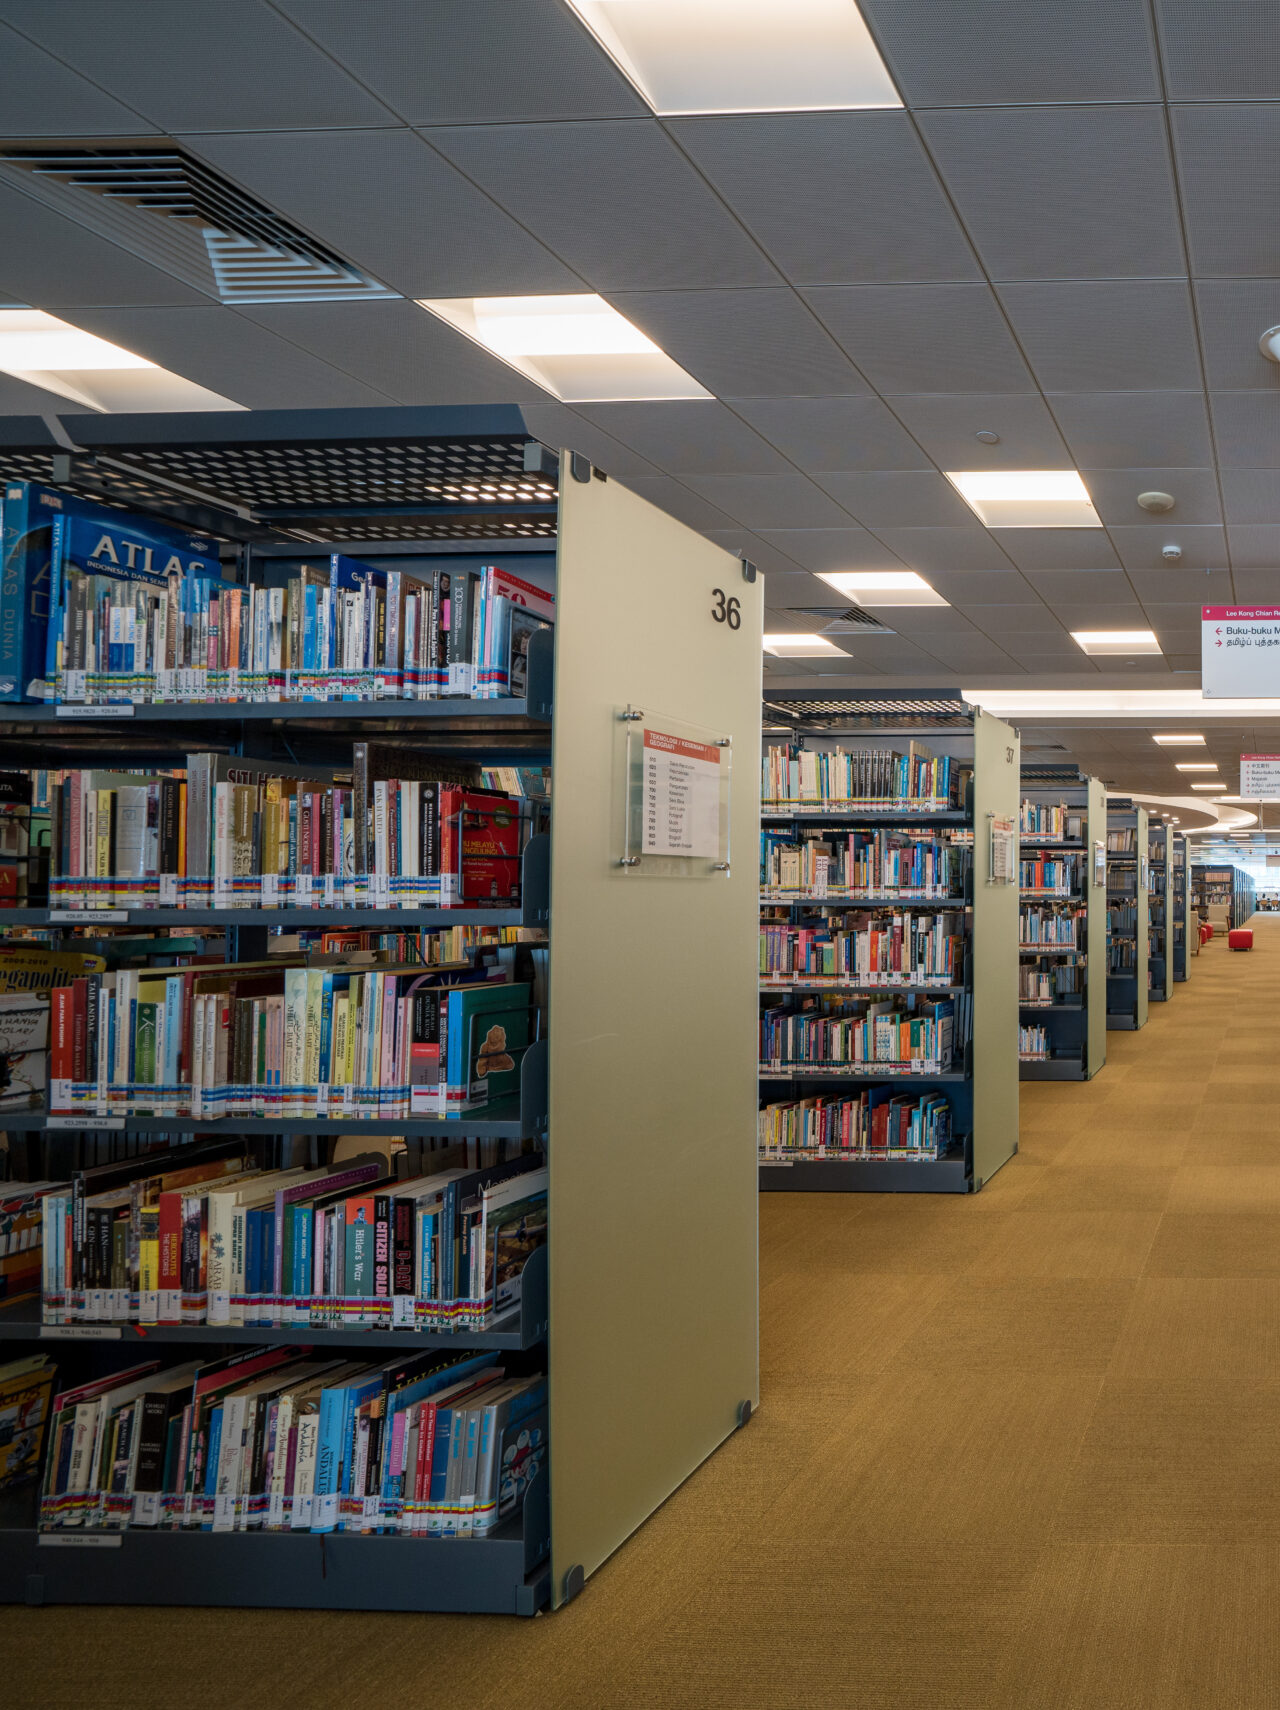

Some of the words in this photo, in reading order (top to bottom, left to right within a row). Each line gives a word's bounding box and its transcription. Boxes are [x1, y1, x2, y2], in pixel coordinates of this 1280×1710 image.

[3, 527, 19, 596] ATLAS
[86, 560, 129, 578] INDONESIA
[131, 572, 149, 584] DAN
[454, 587, 463, 604] 100
[711, 588, 741, 630] 36
[1239, 610, 1255, 618] Kong
[3, 608, 19, 660] DUNIA
[1226, 627, 1272, 635] Buku-buku
[1226, 638, 1252, 648] தமிழ்ப்
[649, 739, 675, 750] GEOGRAFI
[650, 732, 678, 745] TEKNOLOGI
[1006, 746, 1015, 765] 37
[88, 1002, 96, 1032] ANDAK
[88, 1226, 96, 1243] QIN
[162, 1232, 170, 1244] THE
[354, 1229, 365, 1260] Hitler's
[376, 1222, 388, 1262] CITIZEN
[162, 1245, 170, 1276] HISTORIES
[170, 1232, 178, 1276] HERODOTUS
[214, 1261, 222, 1290] ARAB
[354, 1262, 365, 1281] War
[396, 1250, 411, 1290] D-DAY
